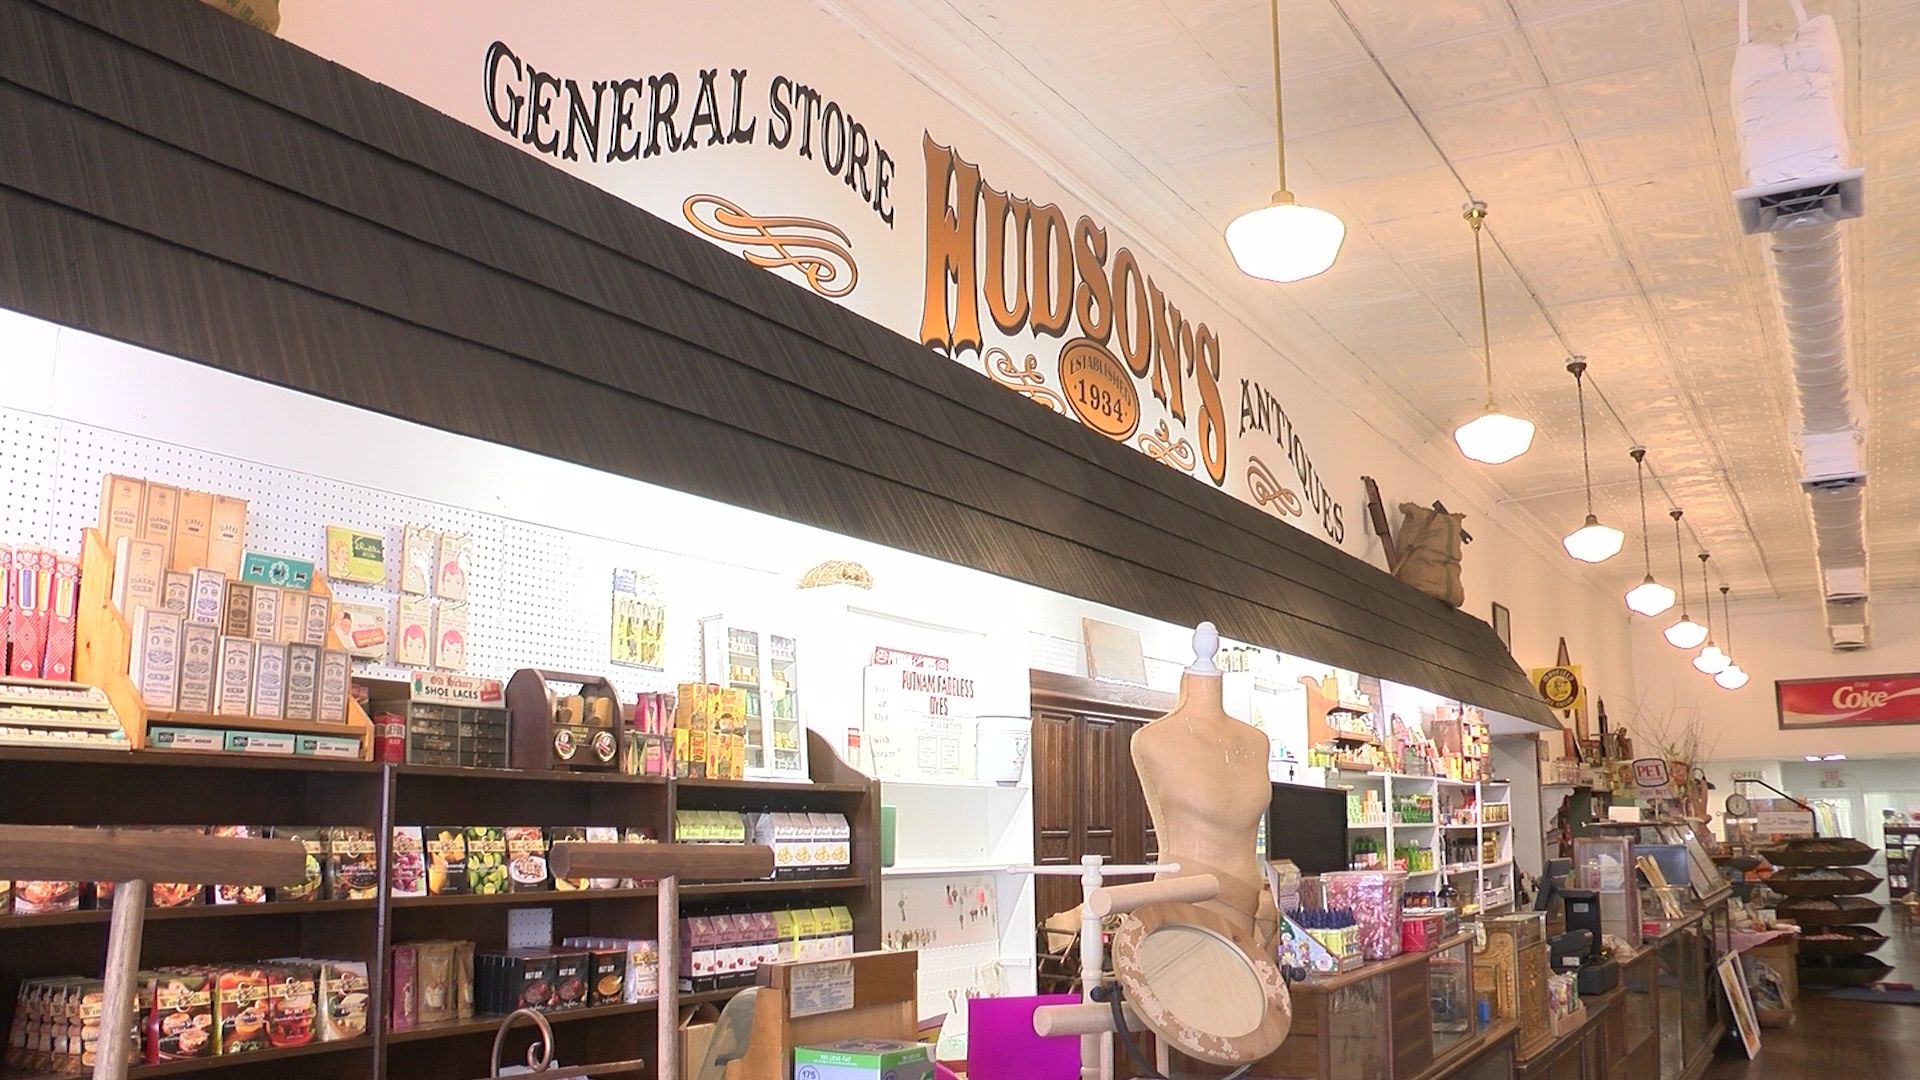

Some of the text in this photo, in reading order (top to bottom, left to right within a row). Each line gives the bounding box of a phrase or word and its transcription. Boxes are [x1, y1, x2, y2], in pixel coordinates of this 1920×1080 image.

[484, 40, 895, 229] GENERAL STORE
[919, 127, 1226, 487] HUDSON'S
[1070, 354, 1131, 407] ESTABLISHED
[1078, 378, 1124, 424] 1934
[1238, 378, 1345, 545] ANTIQUES
[425, 685, 449, 697] SHOE
[453, 689, 479, 700] LACES
[902, 670, 974, 698] PUTNAM FADELESS
[929, 696, 949, 716] DYES
[1832, 686, 1889, 709] Coke
[1637, 765, 1661, 777] PET
[1730, 770, 1763, 780] COFFEE
[802, 1070, 816, 1079] 175
